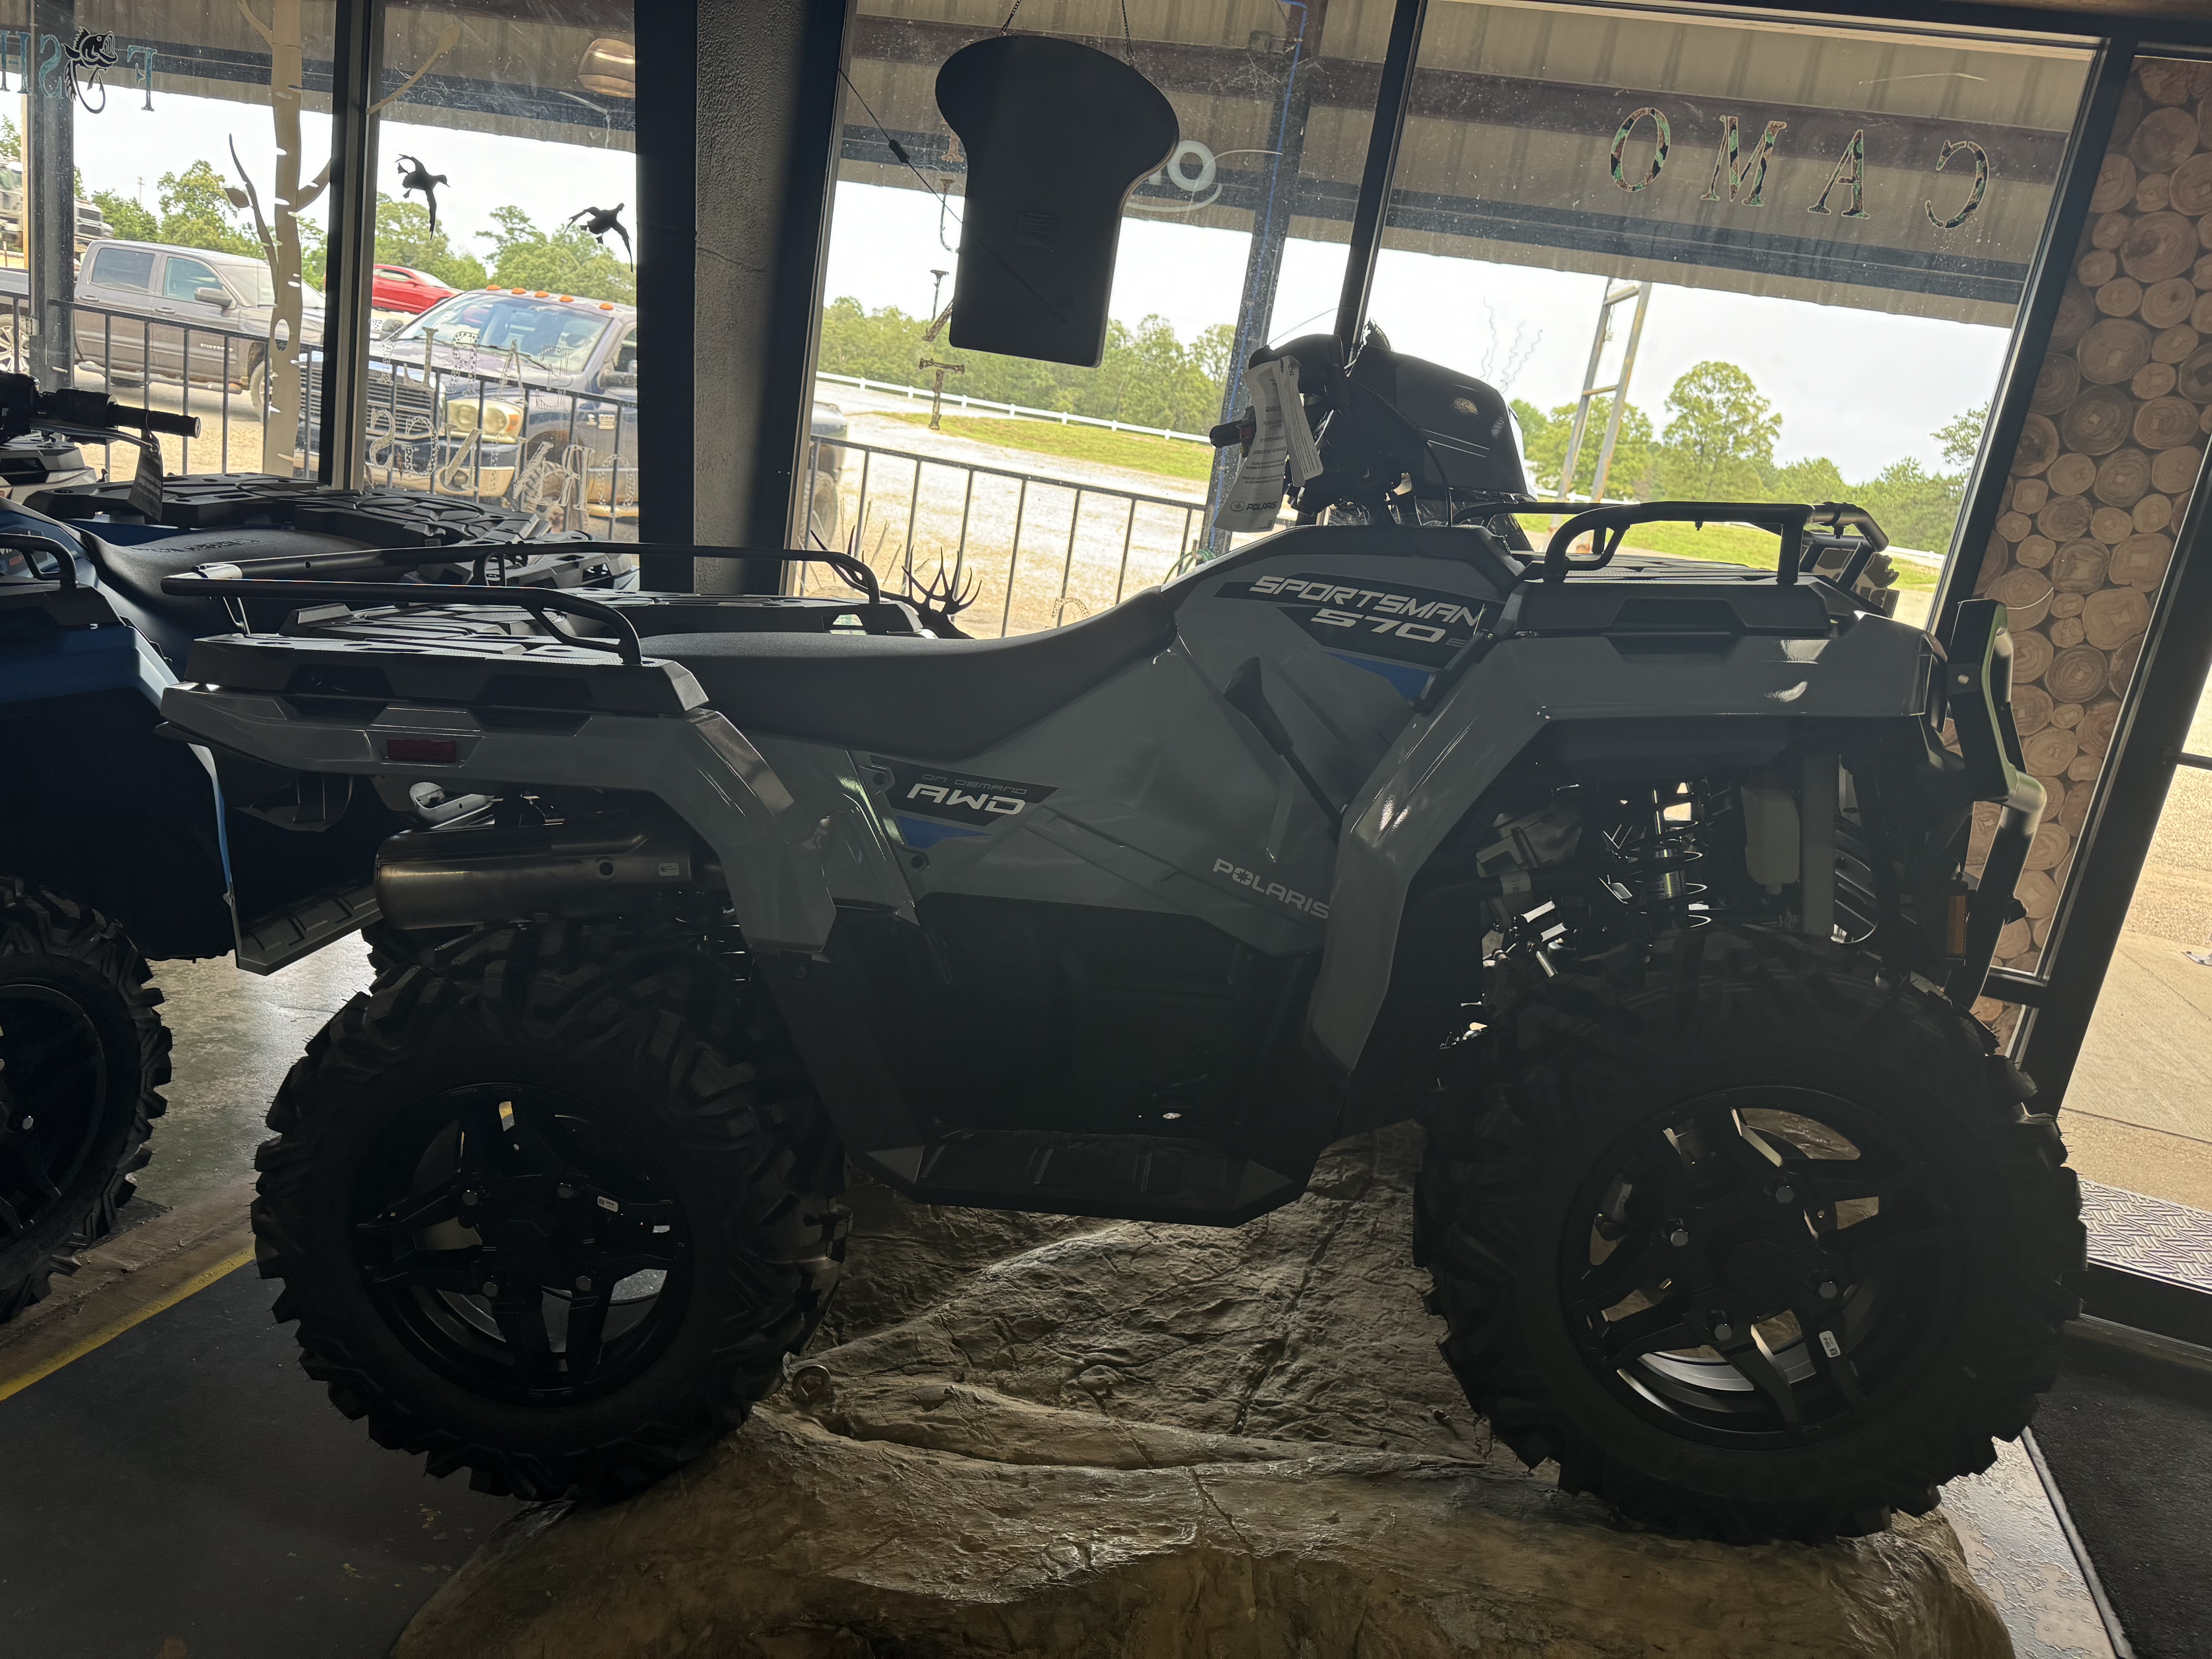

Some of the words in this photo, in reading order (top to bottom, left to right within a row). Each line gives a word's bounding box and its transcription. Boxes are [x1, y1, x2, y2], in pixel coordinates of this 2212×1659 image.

[200, 343, 233, 352] SILVERAO
[1246, 501, 1277, 510] POLARIS
[1249, 575, 1486, 626] SPORTSMAN
[1310, 608, 1446, 642] 570
[907, 783, 1025, 815] AWD
[954, 779, 1027, 794] DEMAND
[1213, 858, 1330, 919] POLARIS
